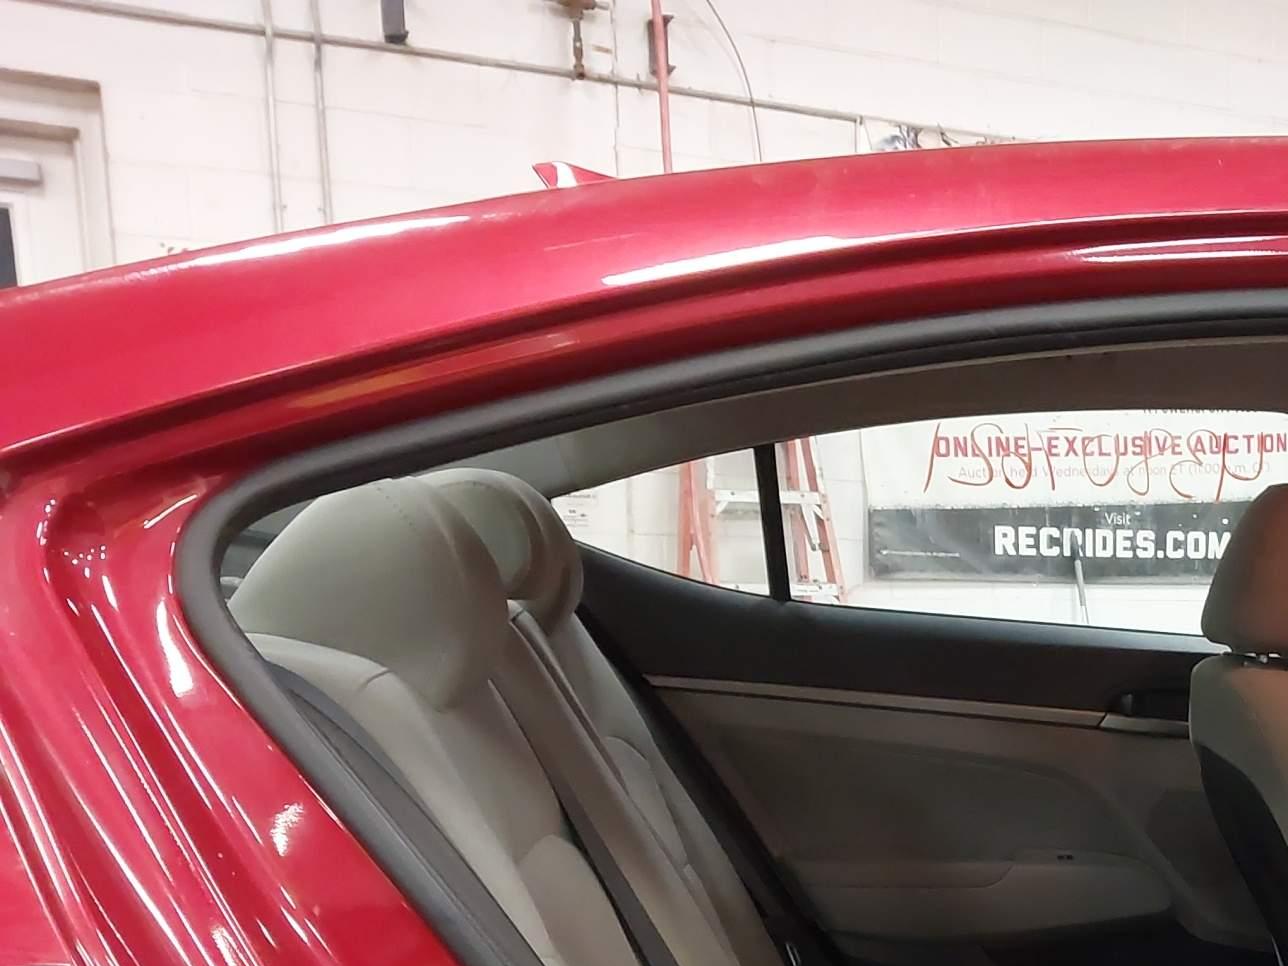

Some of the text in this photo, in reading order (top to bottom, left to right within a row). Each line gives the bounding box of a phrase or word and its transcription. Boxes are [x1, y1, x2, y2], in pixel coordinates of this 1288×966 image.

[1192, 433, 1288, 455] AUCTION
[958, 467, 1002, 479] Aucton
[1010, 466, 1038, 478] hed
[1104, 512, 1132, 525] Visit
